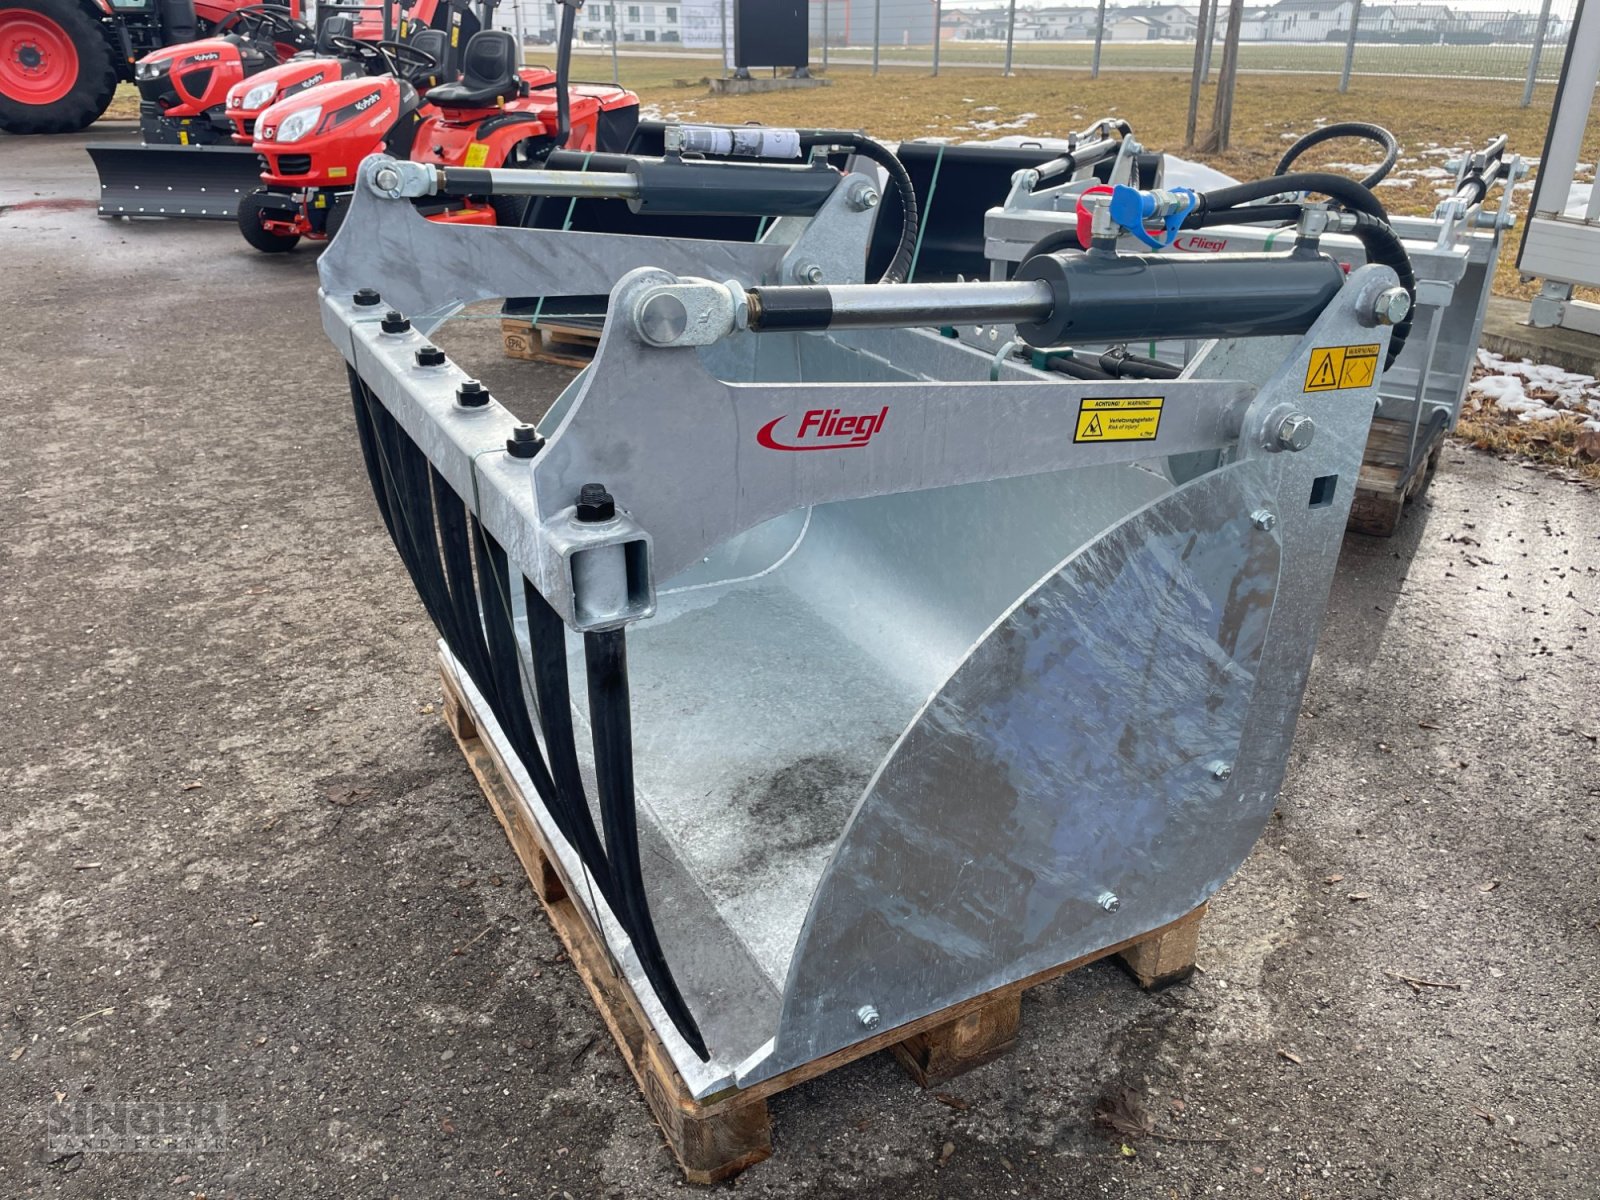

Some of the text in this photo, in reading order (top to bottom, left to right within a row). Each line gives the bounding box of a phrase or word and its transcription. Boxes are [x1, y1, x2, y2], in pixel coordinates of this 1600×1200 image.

[355, 93, 380, 110] Kubota
[1189, 237, 1228, 252] Fliegl
[1348, 346, 1378, 354] WARNING!
[797, 406, 889, 441] Fliegl
